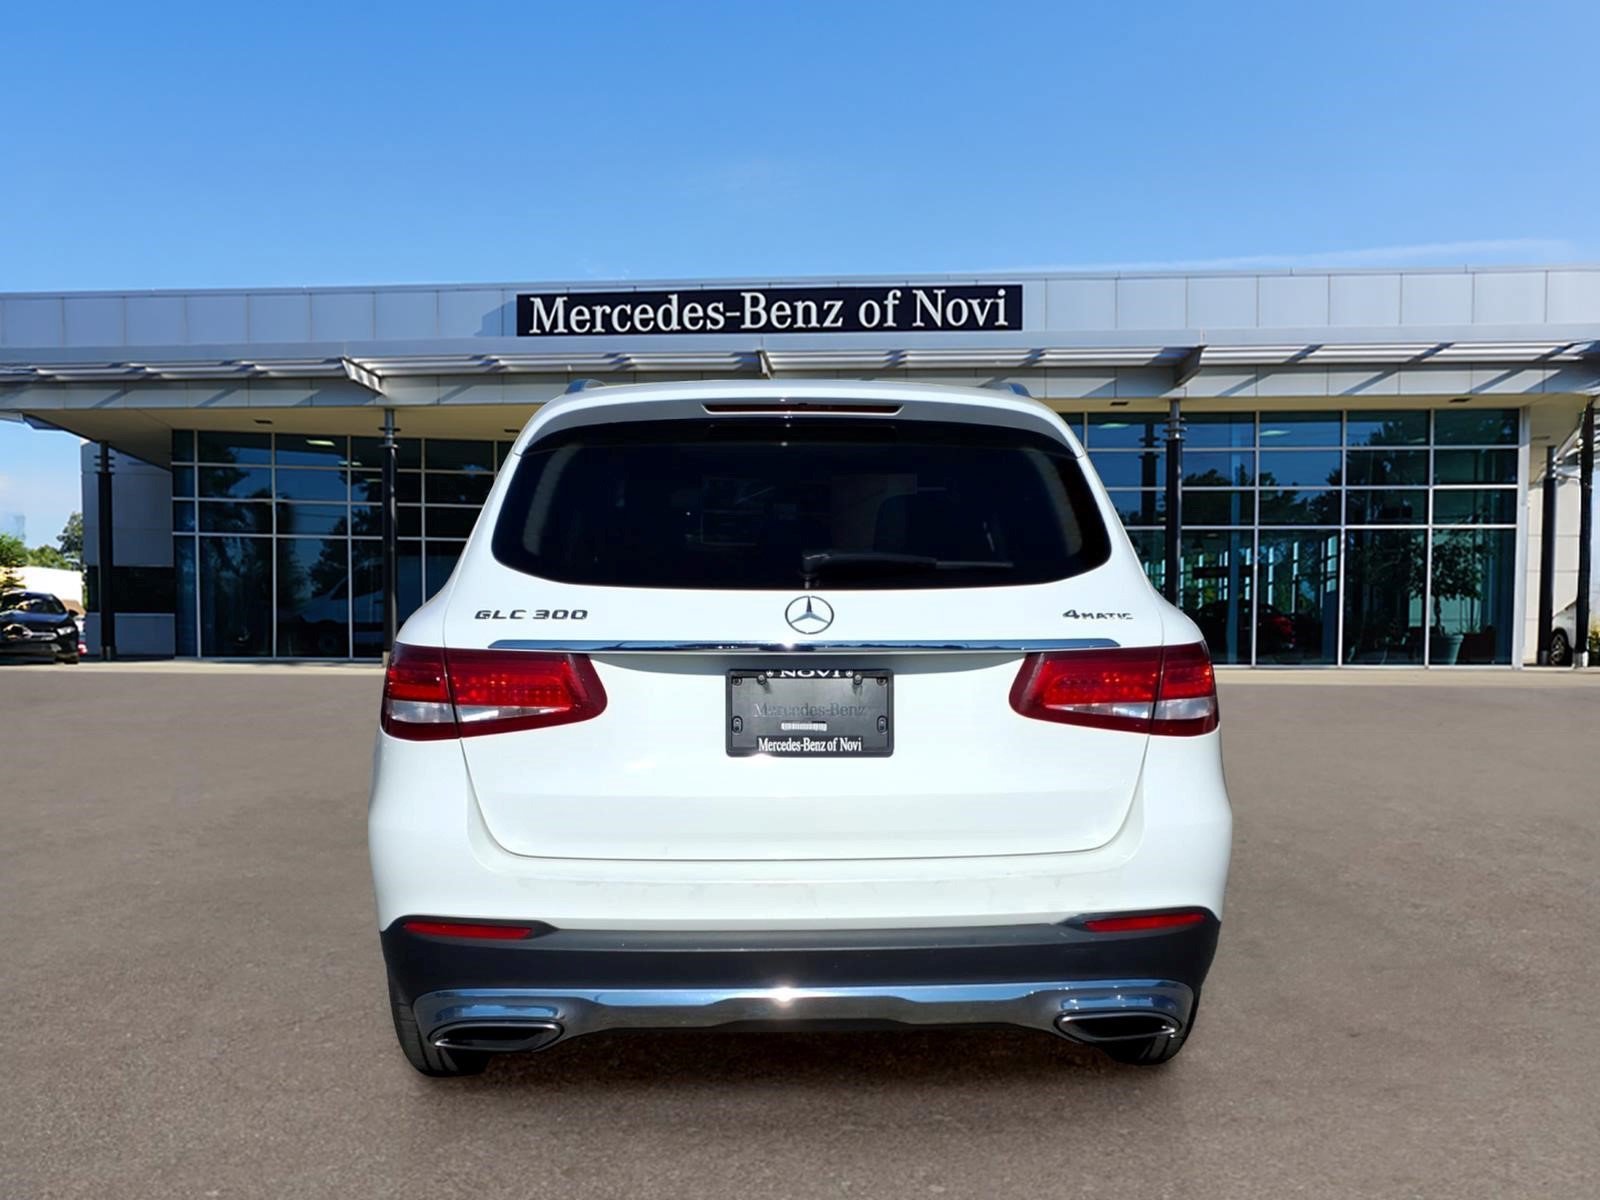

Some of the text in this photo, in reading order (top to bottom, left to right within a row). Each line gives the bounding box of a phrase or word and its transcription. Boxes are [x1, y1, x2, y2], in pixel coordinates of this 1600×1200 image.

[529, 289, 1009, 334] Mercedes-Benz of Novi
[474, 609, 588, 620] GLC 300
[758, 737, 862, 752] Mercedes-Benz of Novi
